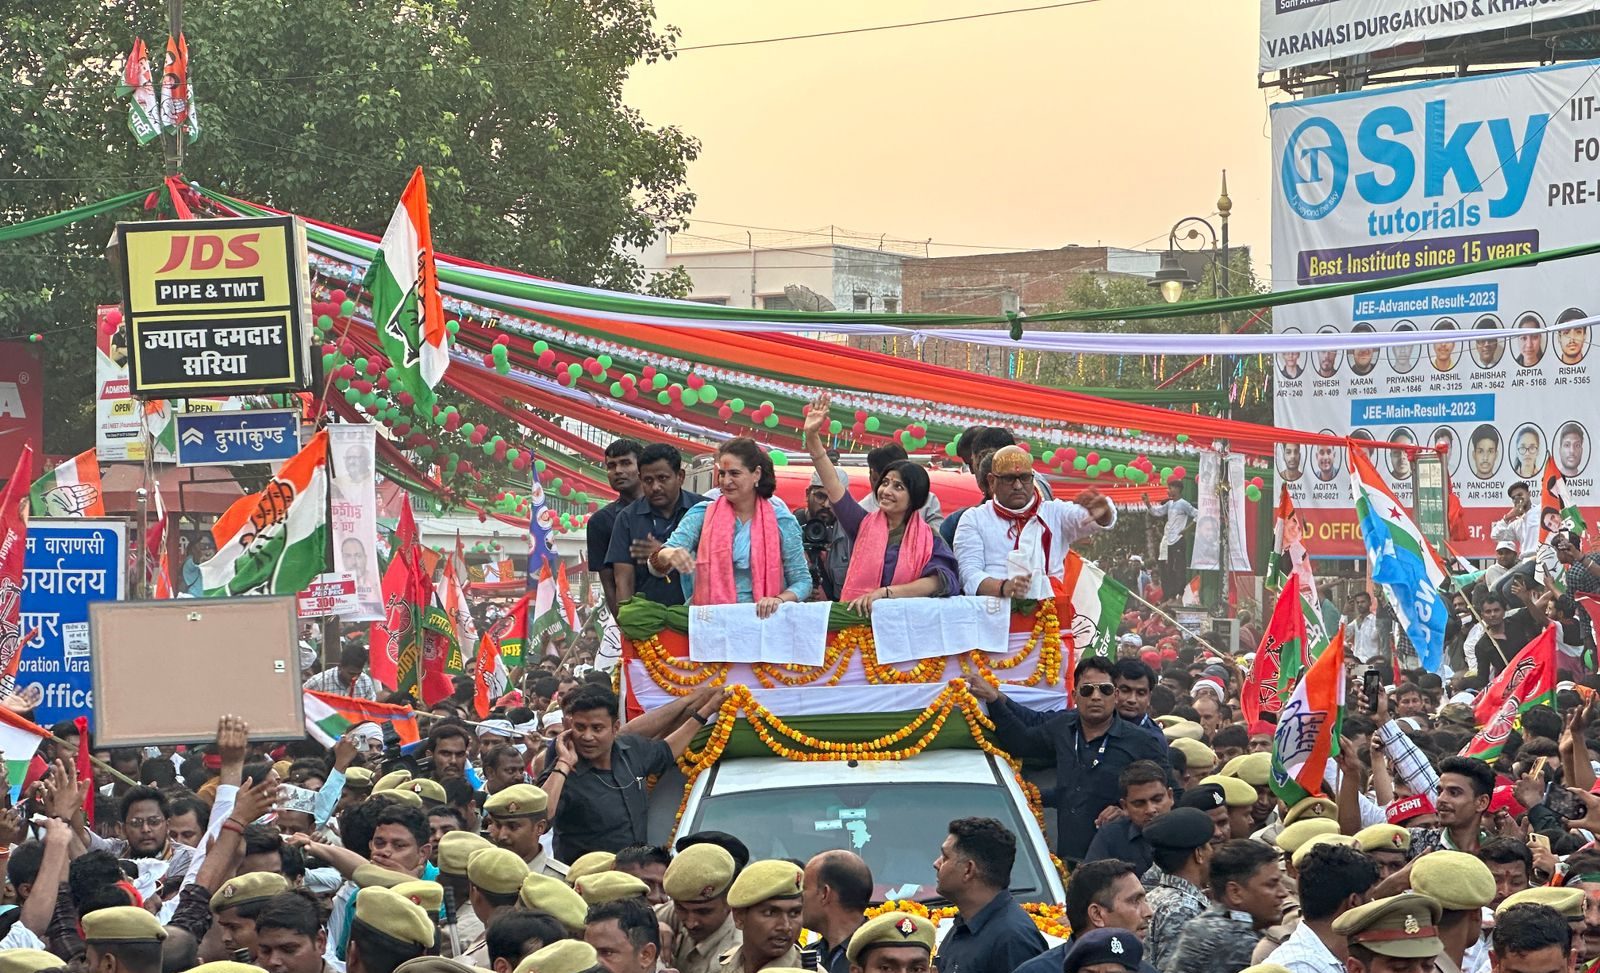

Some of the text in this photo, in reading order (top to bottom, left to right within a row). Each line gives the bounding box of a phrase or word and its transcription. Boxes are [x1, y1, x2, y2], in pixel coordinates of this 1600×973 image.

[1267, 24, 1351, 58] VARANASI
[1354, 1, 1467, 40] DURGAKUND
[1471, 0, 1484, 17] &
[1354, 99, 1550, 218] Sky
[1548, 179, 1600, 207] PRE-
[1368, 200, 1481, 237] tutorials
[155, 233, 261, 274] JDS
[1309, 241, 1532, 278] Best Institute since 15 years
[160, 282, 259, 299] PIPE & TMT
[1355, 297, 1429, 315] JEE-Advanced
[143, 326, 282, 349] ज्यादा दमदार
[182, 350, 248, 376] सरिया
[1558, 366, 1587, 375] RISHAV
[1386, 375, 1425, 384] PRIYANSHU
[1430, 373, 1461, 381] HARSHIL
[1516, 368, 1543, 377] ARPITA
[1350, 378, 1374, 386] KARAN
[114, 403, 131, 413] OPEN
[188, 403, 213, 413] OPEN
[214, 421, 287, 453] दुर्गाकुण्ड
[1285, 483, 1303, 491] MAN
[1314, 482, 1338, 491] ADITYA
[1467, 481, 1505, 489] PANCHDEV
[1467, 491, 1479, 499] AIR
[44, 531, 105, 555] वाराणसी
